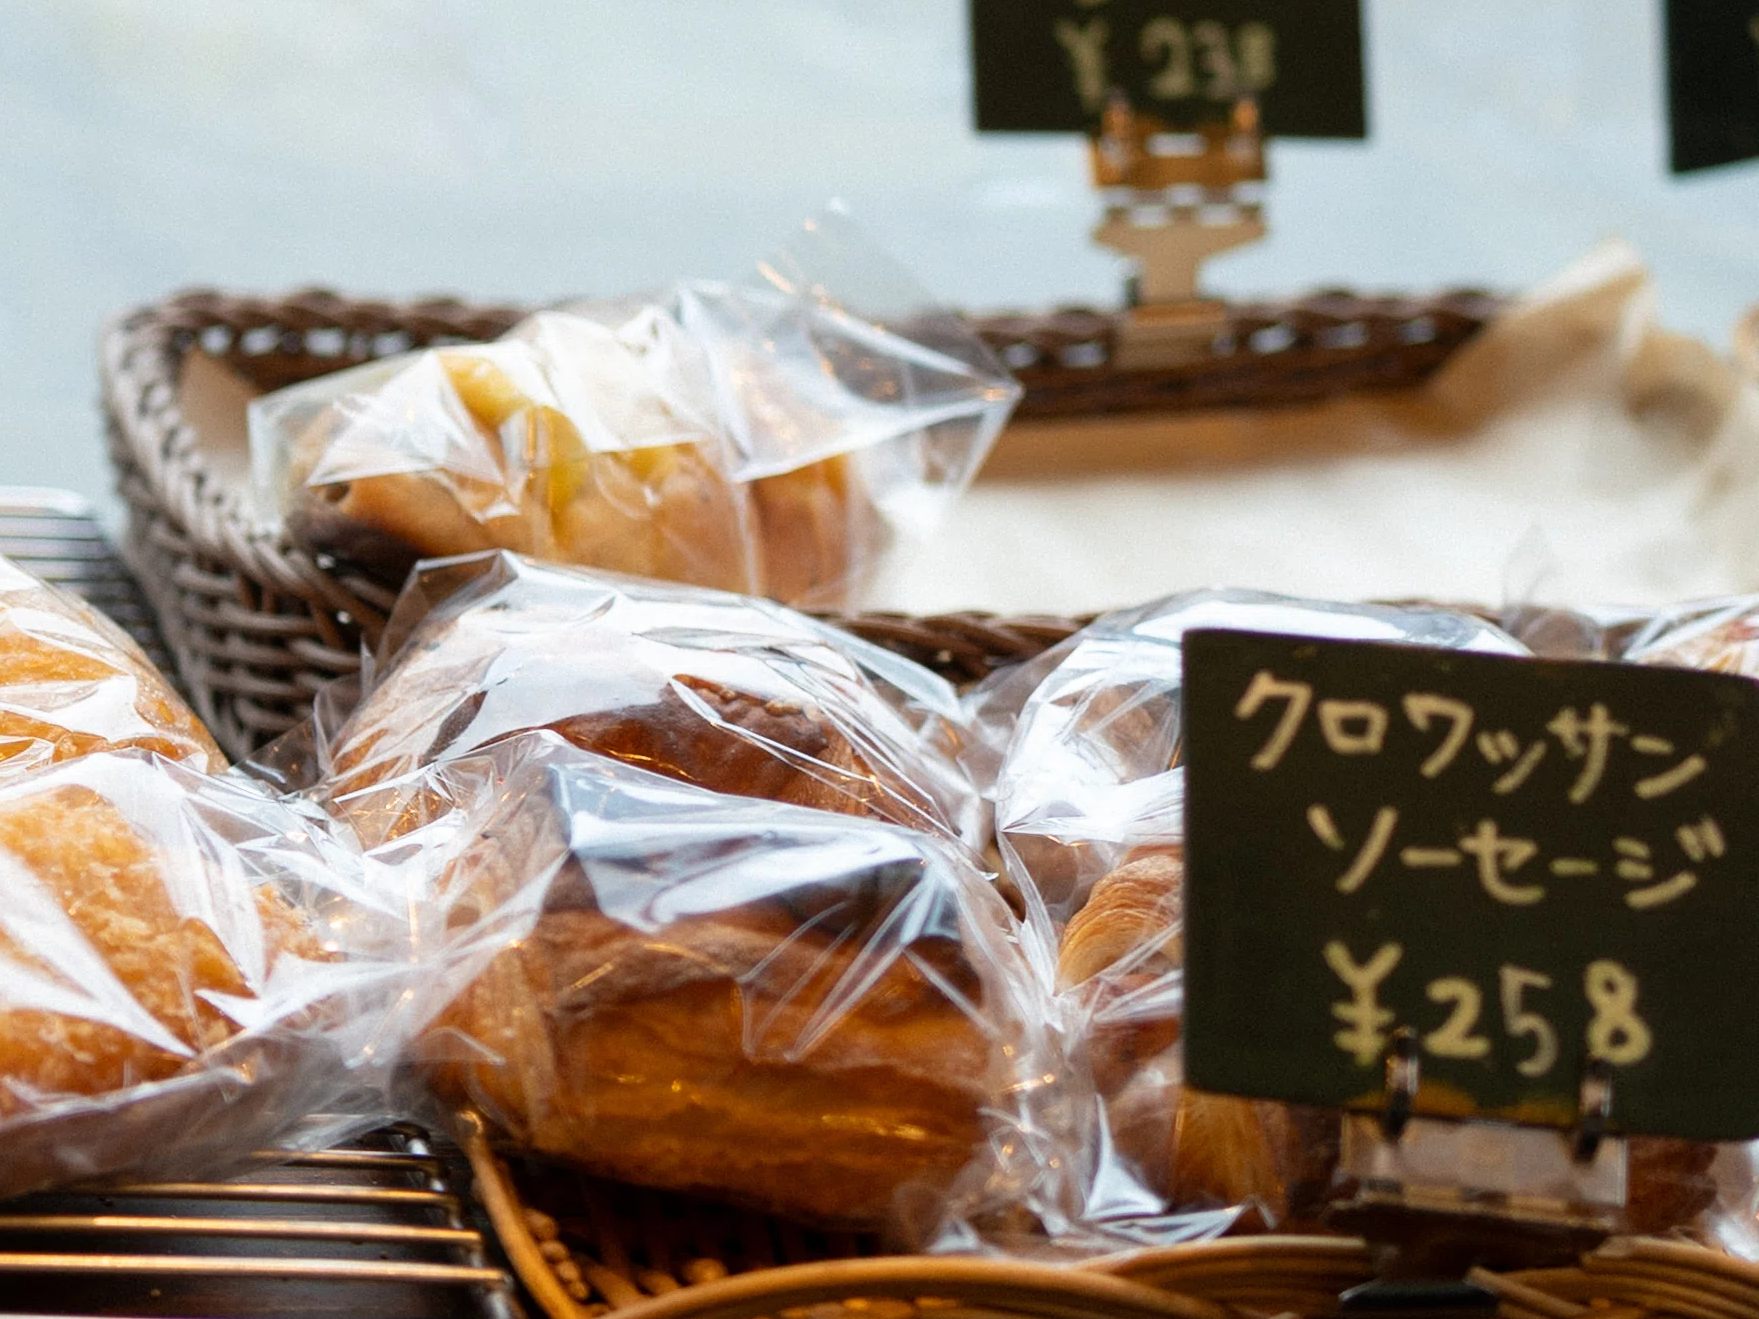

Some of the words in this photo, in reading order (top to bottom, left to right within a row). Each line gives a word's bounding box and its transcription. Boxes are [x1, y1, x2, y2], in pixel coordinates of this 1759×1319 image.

[1234, 671, 1706, 802] クロワッサン
[1307, 803, 1726, 909] ソーセージ
[1323, 940, 1652, 1077] ¥258
